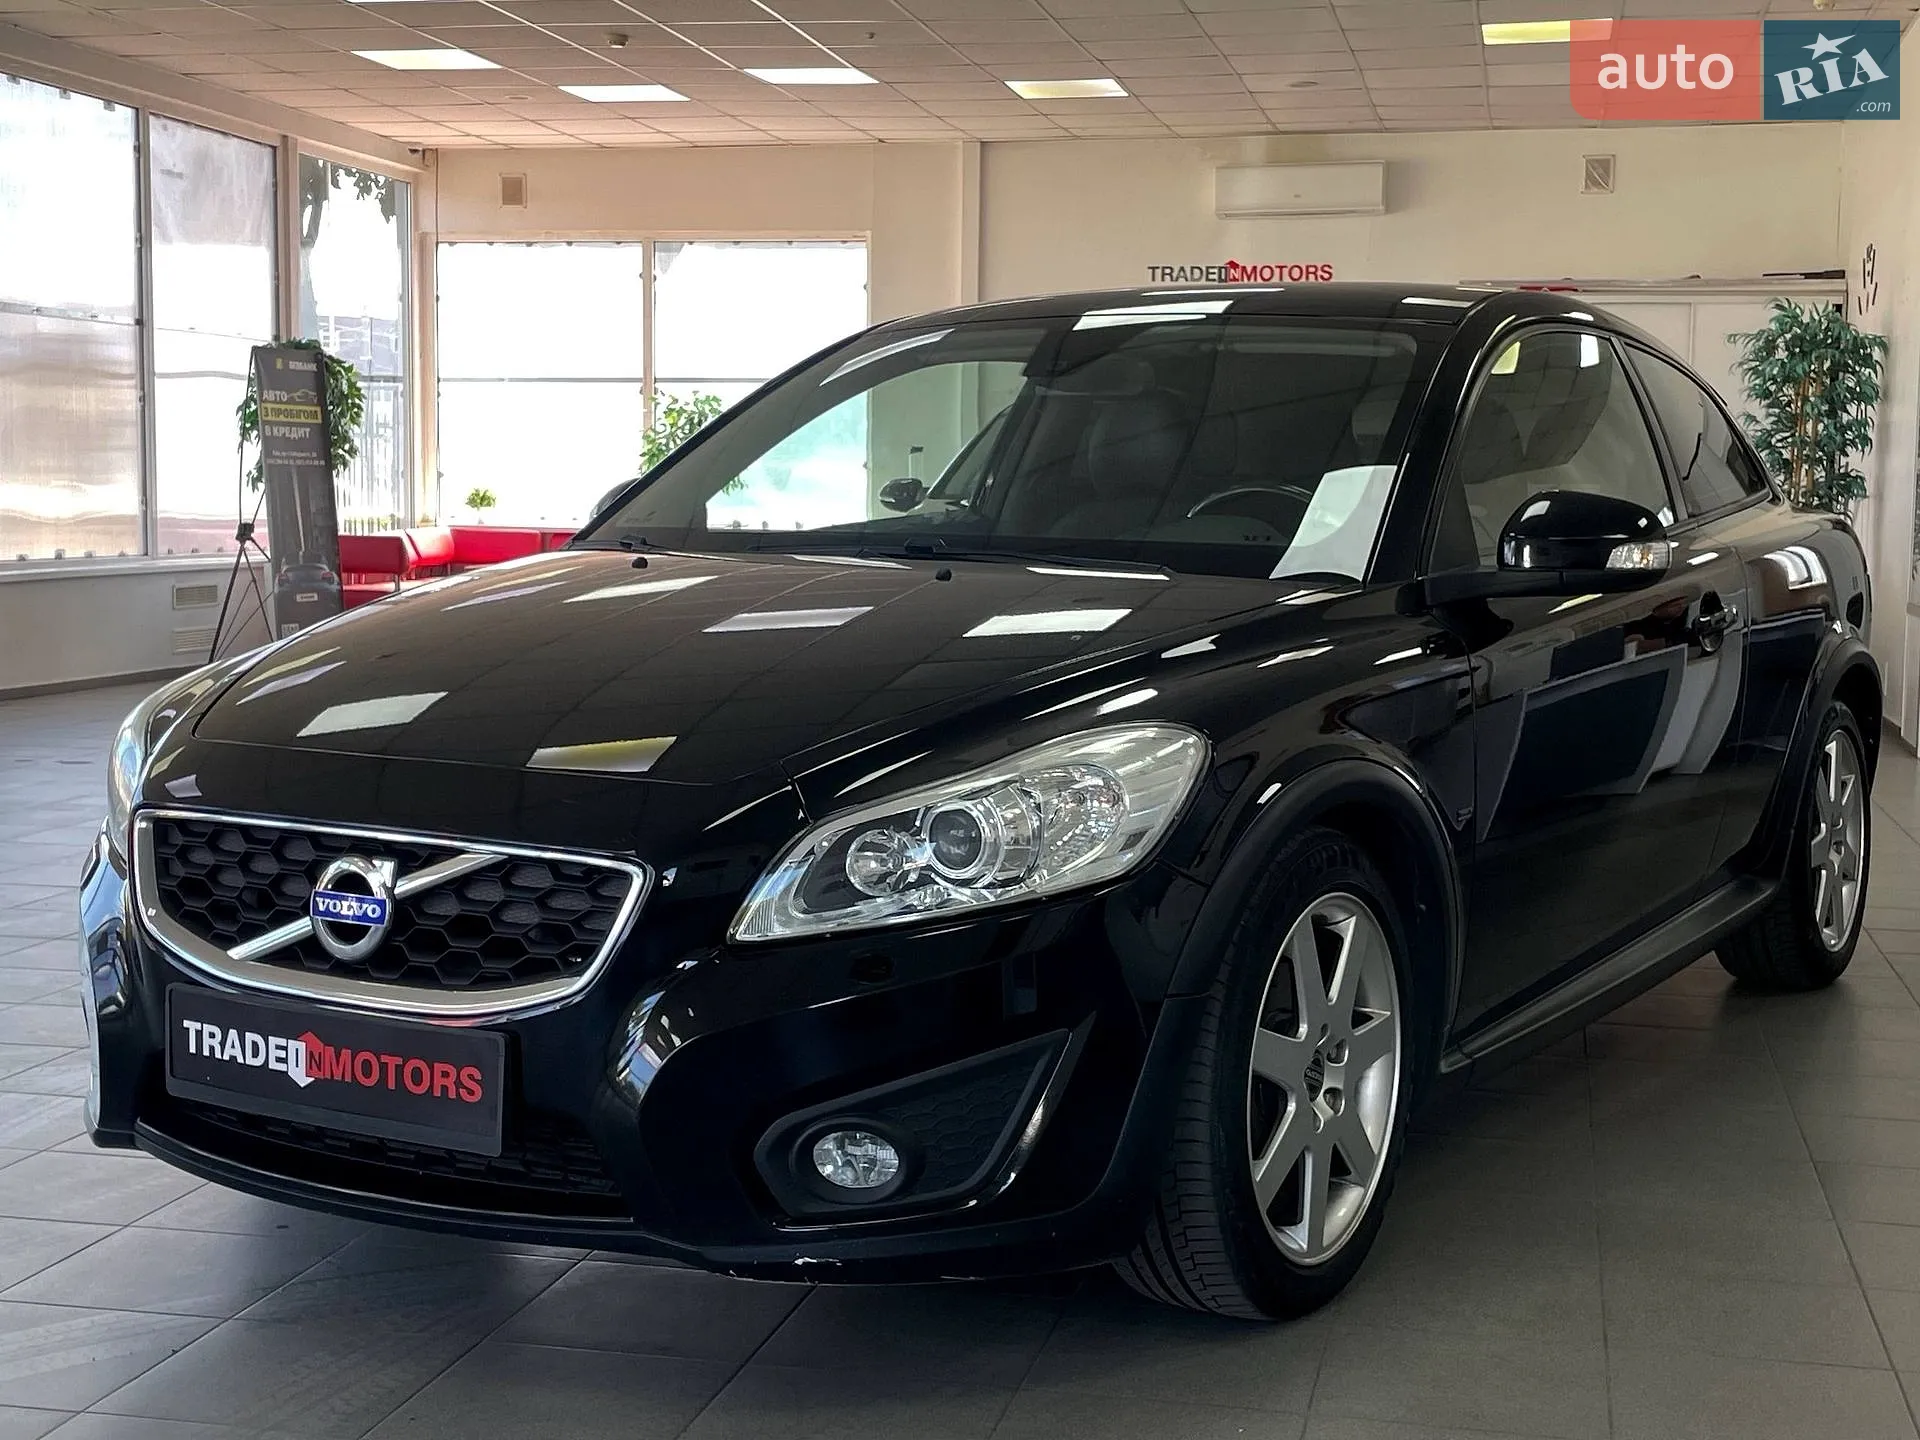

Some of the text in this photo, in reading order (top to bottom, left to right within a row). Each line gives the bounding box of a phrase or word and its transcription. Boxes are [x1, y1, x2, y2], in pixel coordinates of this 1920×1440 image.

[262, 389, 288, 402] АВТО
[264, 424, 311, 440] В КРЕДИТ
[315, 896, 382, 919] VOLVO
